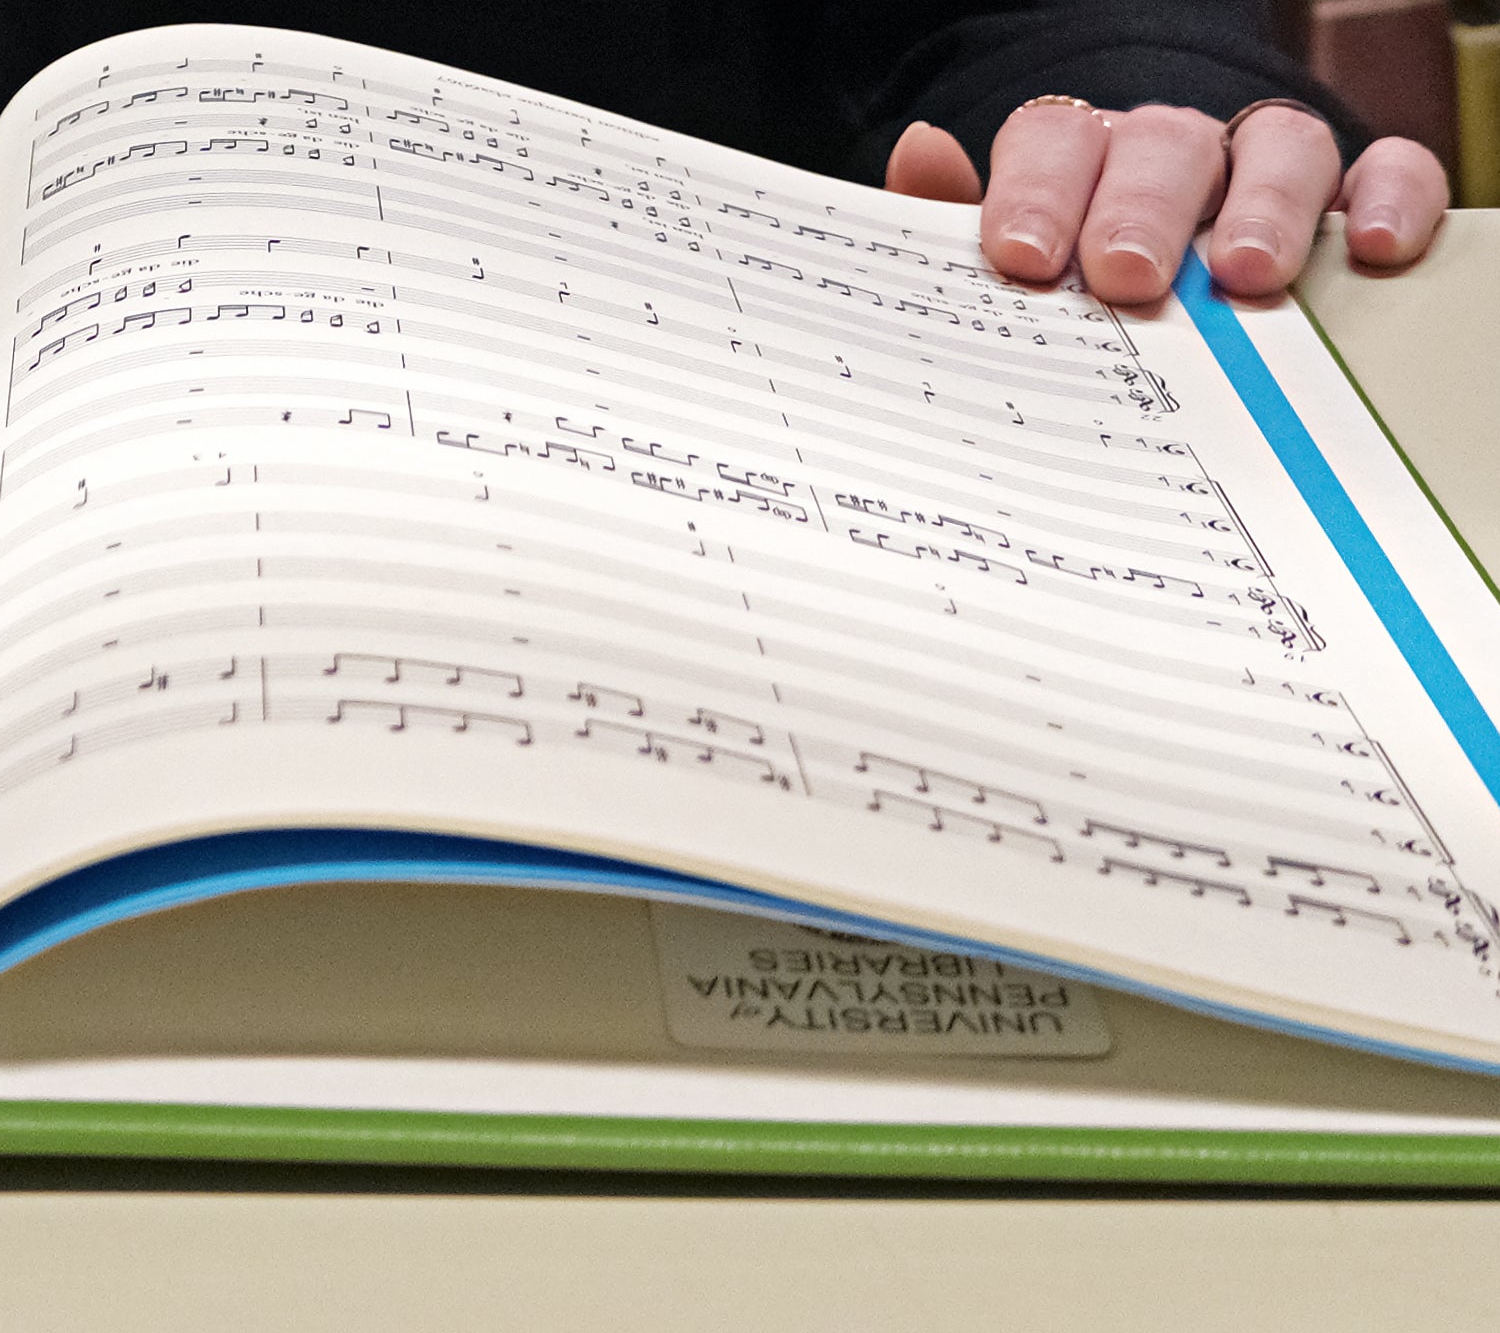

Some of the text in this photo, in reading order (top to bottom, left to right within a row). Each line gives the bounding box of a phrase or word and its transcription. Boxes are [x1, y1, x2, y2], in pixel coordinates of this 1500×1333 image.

[170, 258, 200, 269] die
[323, 294, 345, 304] da
[355, 298, 385, 309] die
[686, 975, 1068, 1010] PENNSYLVANIA
[766, 1006, 1063, 1035] UNIVERSITY
